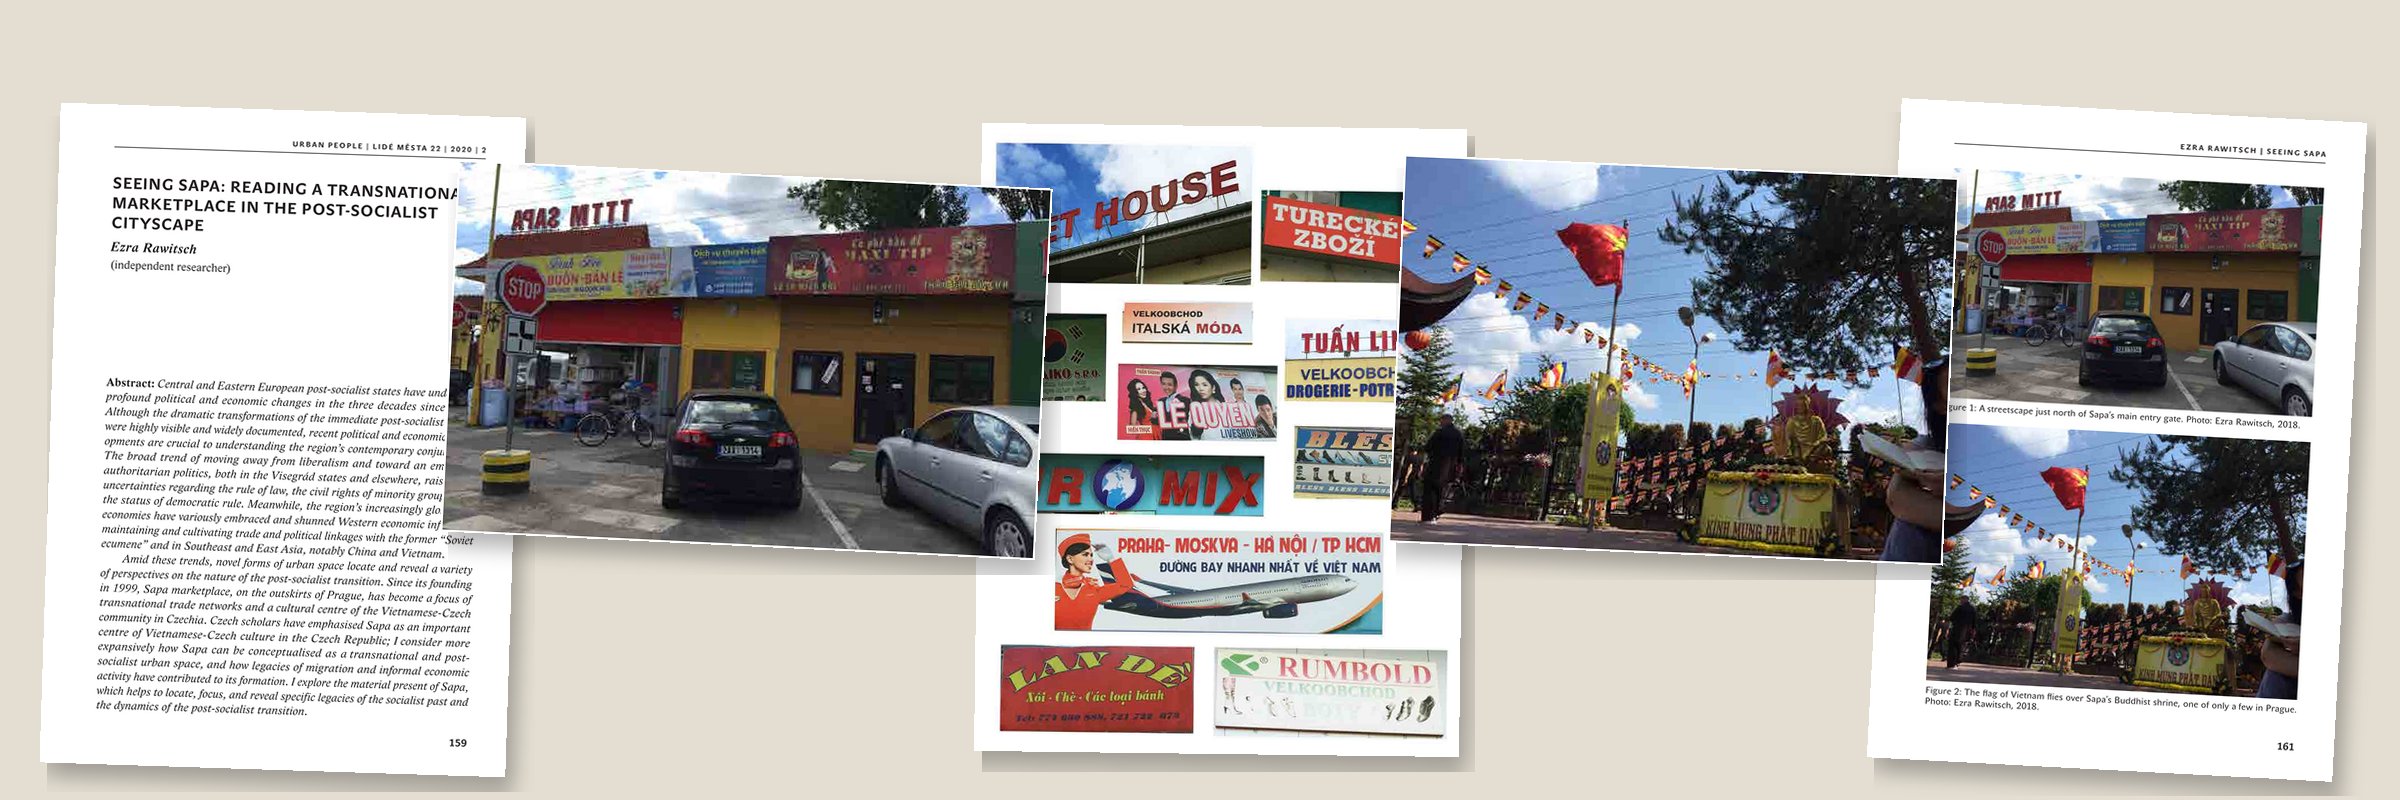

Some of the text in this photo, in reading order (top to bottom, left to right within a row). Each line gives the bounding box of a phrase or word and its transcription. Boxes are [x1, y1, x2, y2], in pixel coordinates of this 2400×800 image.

[292, 140, 325, 149] URBAN
[327, 141, 363, 150] PEOPLE
[450, 145, 473, 153] 2020
[2180, 143, 2327, 158] EZRA RAWITSCH SEEING SAPA
[113, 176, 173, 191] SEEING
[179, 178, 224, 193] SAPA:
[231, 180, 306, 196] READING
[312, 183, 322, 196] A
[1094, 160, 1239, 230] HOUSE
[113, 196, 438, 220] MARKETPLACE IN THE POST-SOCIALIST
[112, 216, 203, 232] CITYSCAPE
[1273, 202, 1398, 239] TURECKÉ
[110, 241, 197, 255] Ezra Rawitsch
[1293, 228, 1376, 257] ZBOŽÍ
[1983, 241, 2003, 254] STOP
[111, 260, 230, 274] (independent researcher)
[508, 276, 542, 300] STOP
[1132, 310, 1203, 318] VELKOOBCHOD
[1132, 321, 1242, 334] ITALSKÁ MÓDA
[1301, 324, 1360, 353] TUẤN
[107, 378, 154, 388] Abstract:
[158, 379, 194, 389] Central
[196, 381, 215, 390] and
[218, 381, 255, 391] Eastern
[258, 383, 304, 394] European
[307, 386, 370, 395] post-socialist
[372, 388, 401, 396] states
[404, 387, 426, 397] have
[1286, 384, 1351, 398] DROGERIE
[1979, 404, 1985, 412] A
[1986, 406, 2034, 416] streetscape
[2035, 408, 2051, 418] just
[2053, 409, 2076, 417] north
[2078, 410, 2087, 418] of
[2090, 410, 2115, 420] Sapa’s
[2140, 415, 2162, 424] entry
[2164, 416, 2184, 424] gate.
[2187, 415, 2213, 424] Photo:
[2216, 417, 2233, 426] Ezra
[2236, 418, 2275, 428] Rawitsch,
[2278, 420, 2301, 429] 2018.
[1159, 465, 1261, 515] MIX
[1175, 537, 1238, 554] MOSKVA
[1322, 537, 1341, 554] TP
[1346, 537, 1381, 554] HCM
[1201, 562, 1223, 573] BAY
[1227, 562, 1265, 573] NHANH
[1352, 562, 1381, 573] NAM
[97, 657, 469, 677] socialist urban space, and how legacies of migration and informal economic
[1007, 651, 1110, 692] LAN
[1277, 656, 1432, 685] RUMBOLD
[1025, 690, 1165, 705] Xôi Chè Các loại bánh
[1264, 681, 1397, 699] VELKOOBCHOD
[1925, 697, 2038, 711] Photo: Ezra Rawitsch, 2018.
[1926, 685, 1951, 698] Figure
[1954, 687, 1961, 697] 2:
[1965, 687, 1980, 697] The
[1983, 688, 1997, 700] flag
[2000, 690, 2008, 698] of
[2011, 690, 2044, 701] Vietnam
[2047, 692, 2063, 701] flies
[2087, 694, 2111, 705] Sapa’s
[2115, 695, 2150, 706] Buddhist
[2153, 698, 2179, 709] shrine,
[2183, 701, 2198, 709] one
[2201, 700, 2209, 709] of
[2212, 702, 2229, 712] only
[2239, 702, 2253, 711] few
[2266, 704, 2296, 715] Prague.
[449, 738, 468, 748] 159
[2277, 741, 2294, 752] 161
